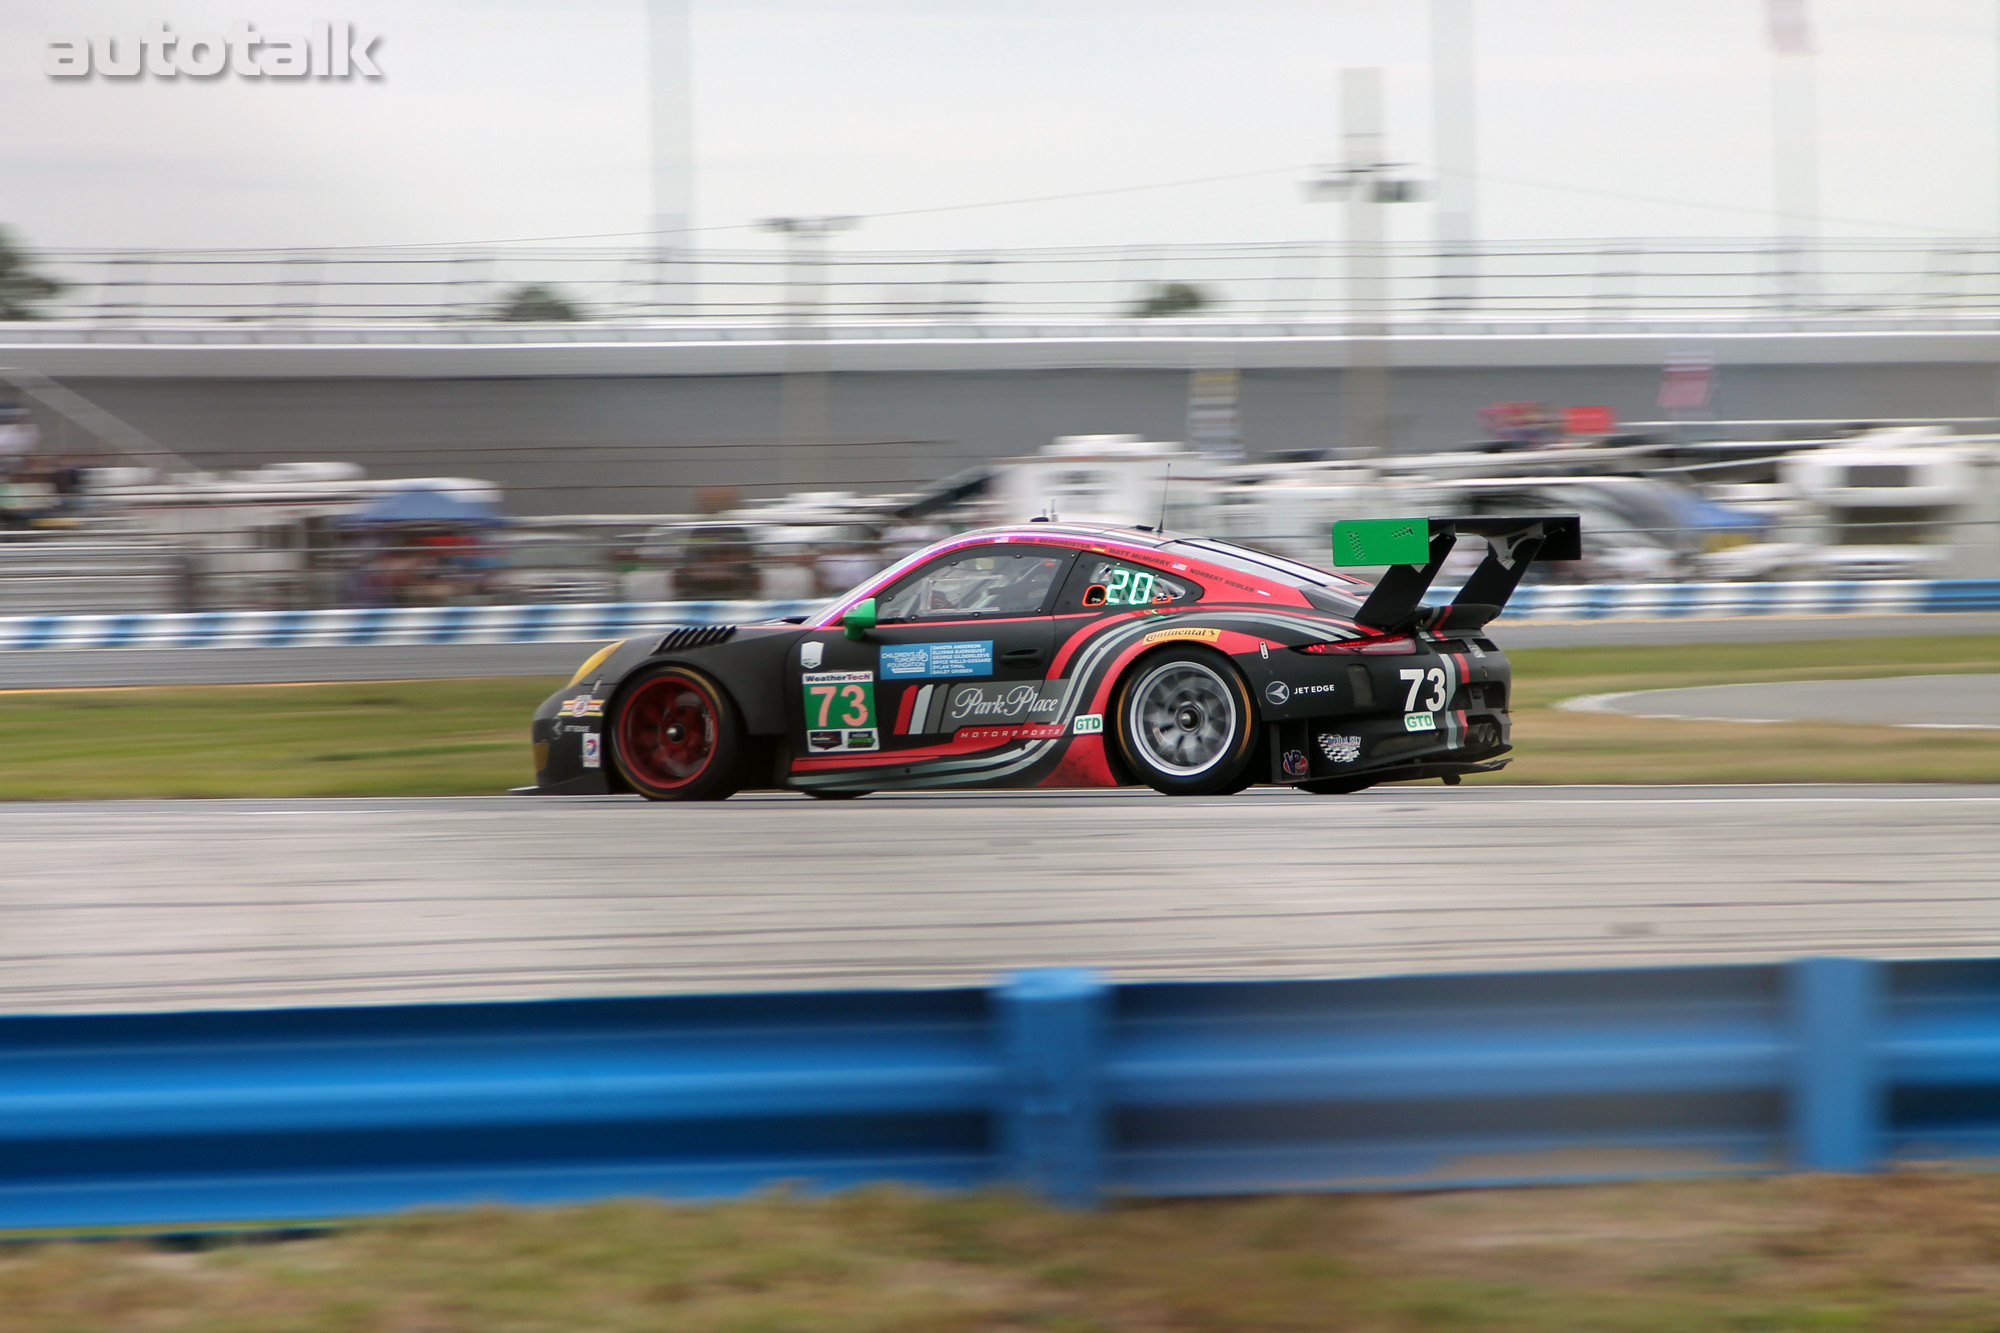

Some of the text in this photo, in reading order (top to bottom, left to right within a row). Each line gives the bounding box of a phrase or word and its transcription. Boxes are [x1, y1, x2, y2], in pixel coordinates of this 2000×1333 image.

[1108, 548, 1130, 557] MATT
[1190, 568, 1255, 592] NORBERT SIEDLER
[1106, 570, 1154, 604] 20
[1146, 629, 1207, 642] Continental
[805, 674, 871, 682] WeatherTech
[1312, 684, 1334, 692] EDGE
[1400, 668, 1446, 712] 73
[810, 684, 868, 726] 73
[952, 686, 1058, 718] Park Place
[1076, 718, 1100, 730] GTD
[1406, 714, 1432, 728] GTD
[961, 729, 1060, 738] MOTORSPORTS
